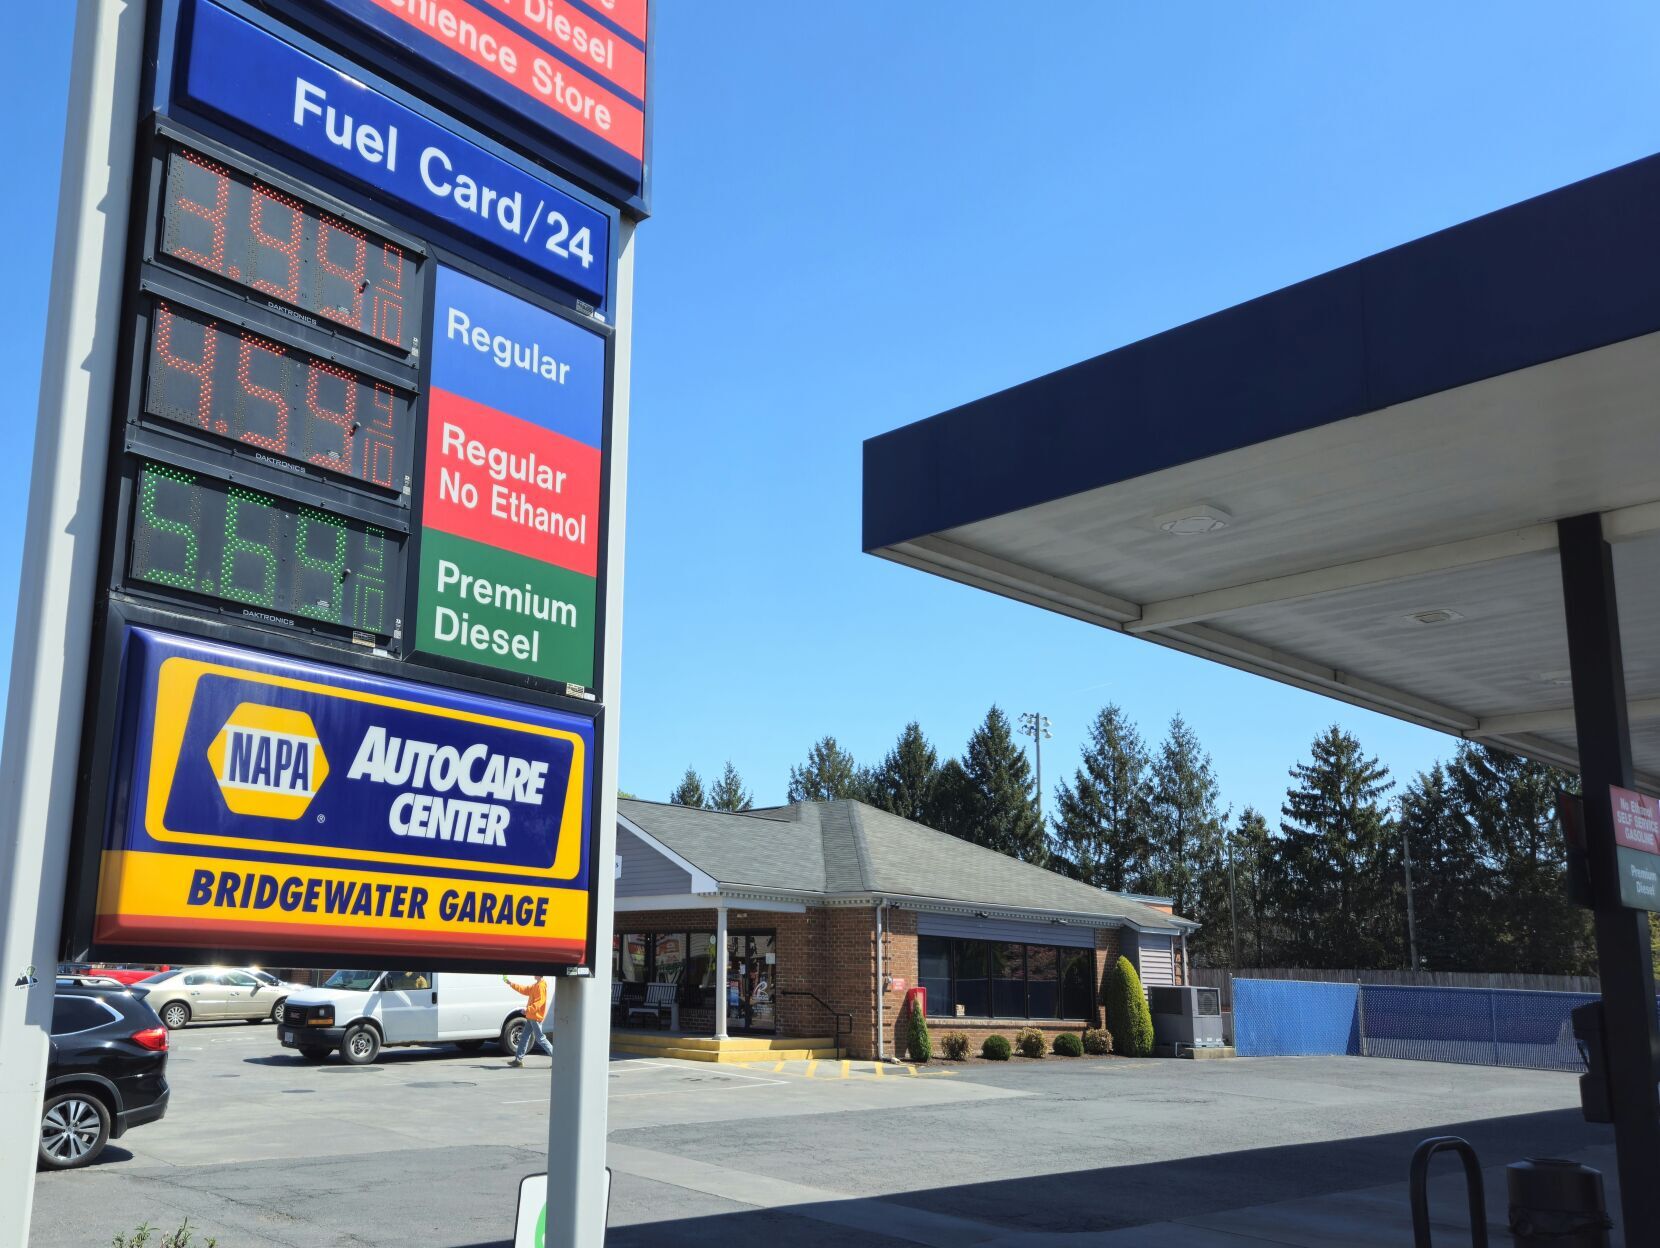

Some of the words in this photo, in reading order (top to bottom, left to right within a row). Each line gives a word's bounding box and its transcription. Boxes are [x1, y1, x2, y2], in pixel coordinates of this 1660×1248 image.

[531, 58, 612, 130] Store
[293, 77, 397, 172] Fuel
[419, 146, 594, 269] Card/24
[173, 149, 368, 331] 3.99
[267, 301, 317, 326] DAKTRONICS
[447, 306, 570, 385] Regular
[155, 301, 359, 474] 4.59
[255, 452, 306, 474] DAKTRONICS
[441, 421, 567, 494] Regular
[439, 467, 478, 509] No
[491, 484, 586, 544] Ethanol
[141, 462, 348, 624] 5.69
[242, 609, 295, 627] DAKTRONICS
[437, 559, 577, 628] Premium
[434, 606, 539, 663] Diesel
[228, 731, 310, 793] NAPA
[388, 793, 511, 847] CENTER
[1617, 811, 1632, 824] SELF
[1635, 815, 1659, 833] SERVICE
[1620, 797, 1630, 810] No
[1625, 827, 1654, 845] GASOLINE
[187, 869, 429, 920] BRIDGEWATER
[439, 889, 550, 928] GARAGE
[1631, 864, 1656, 881] Premium
[1636, 881, 1656, 896] Diesel
